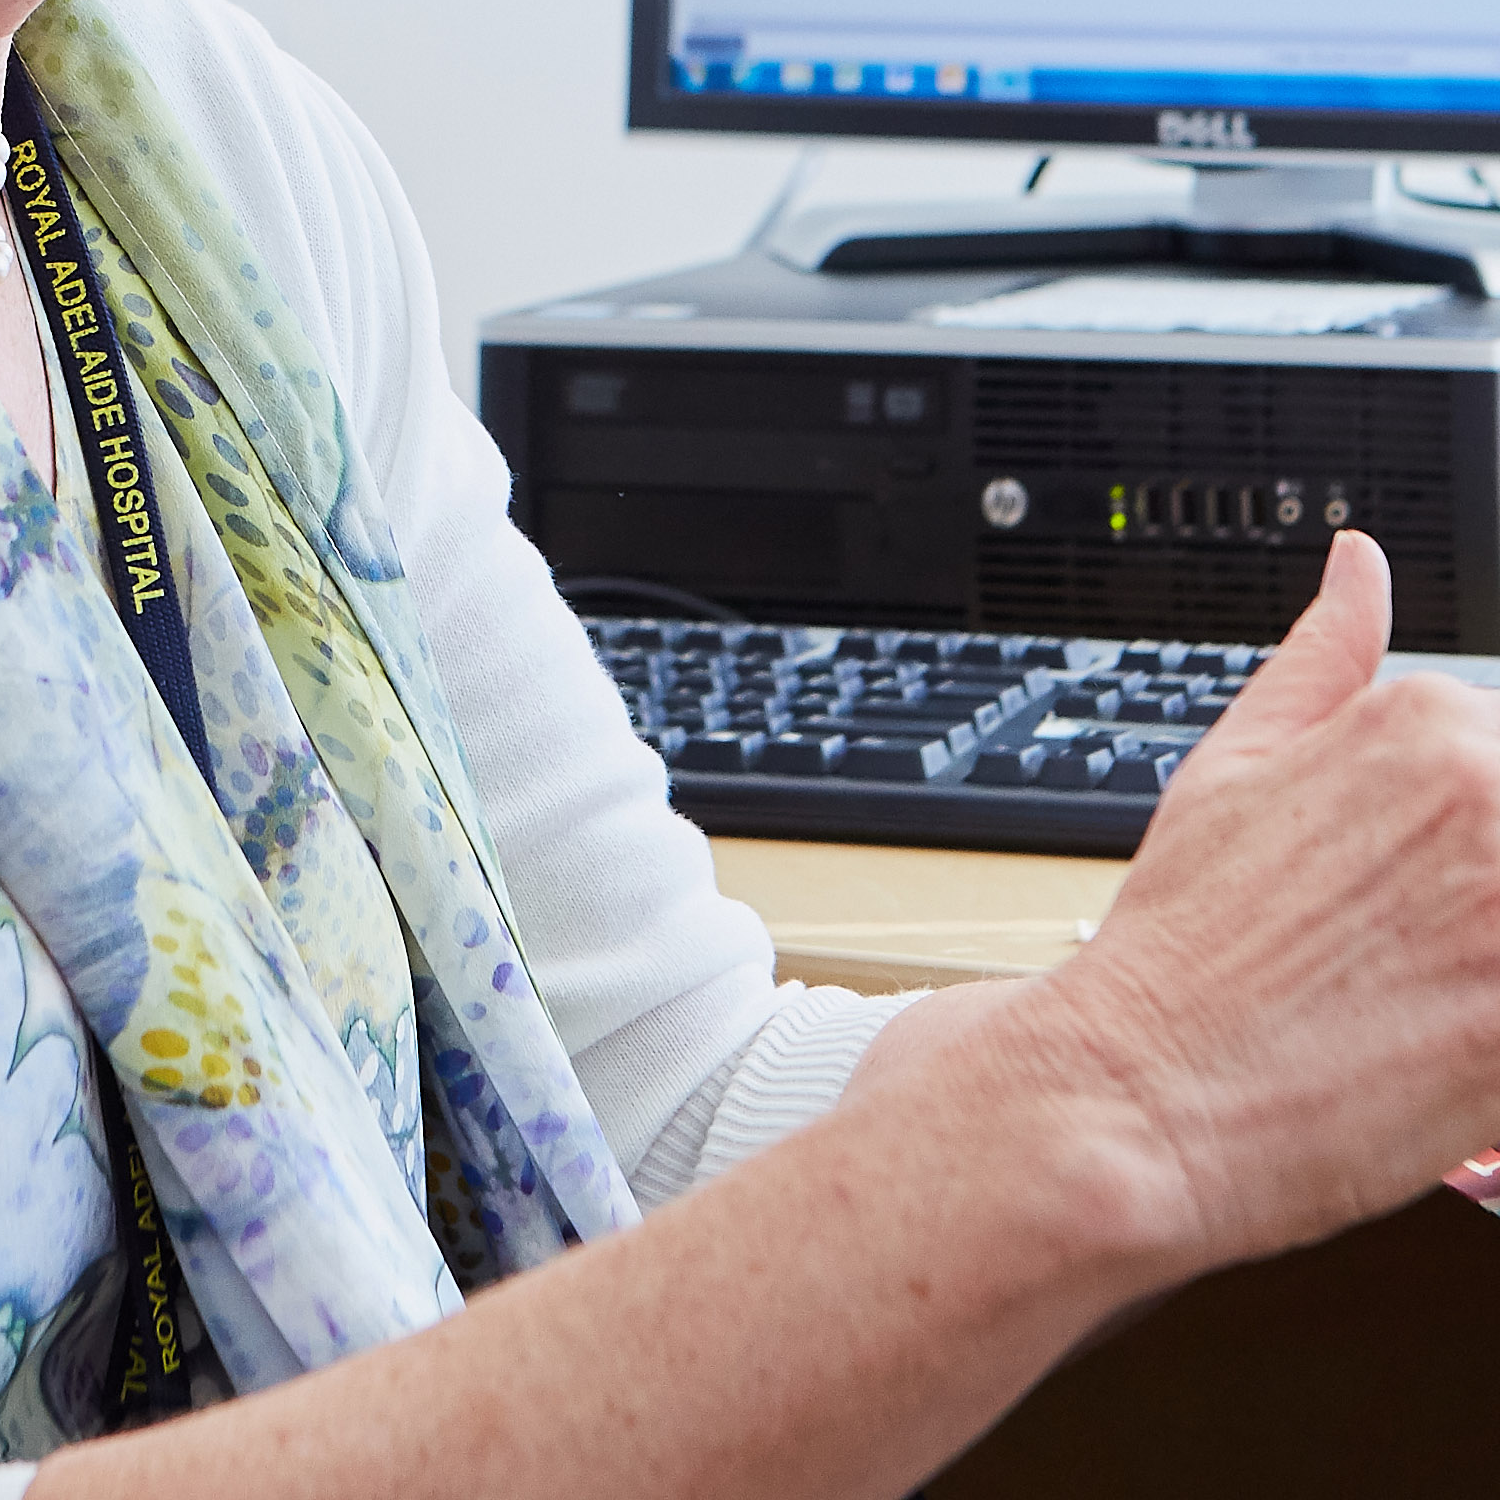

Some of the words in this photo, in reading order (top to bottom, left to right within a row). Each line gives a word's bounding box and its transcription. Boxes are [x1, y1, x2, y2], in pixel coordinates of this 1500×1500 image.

[1156, 109, 1258, 150] DELL
[11, 139, 67, 256] ROYAL
[45, 261, 126, 432] ADELAIDE
[99, 433, 165, 615] HOSPITAL
[143, 1237, 181, 1375] ROYAL
